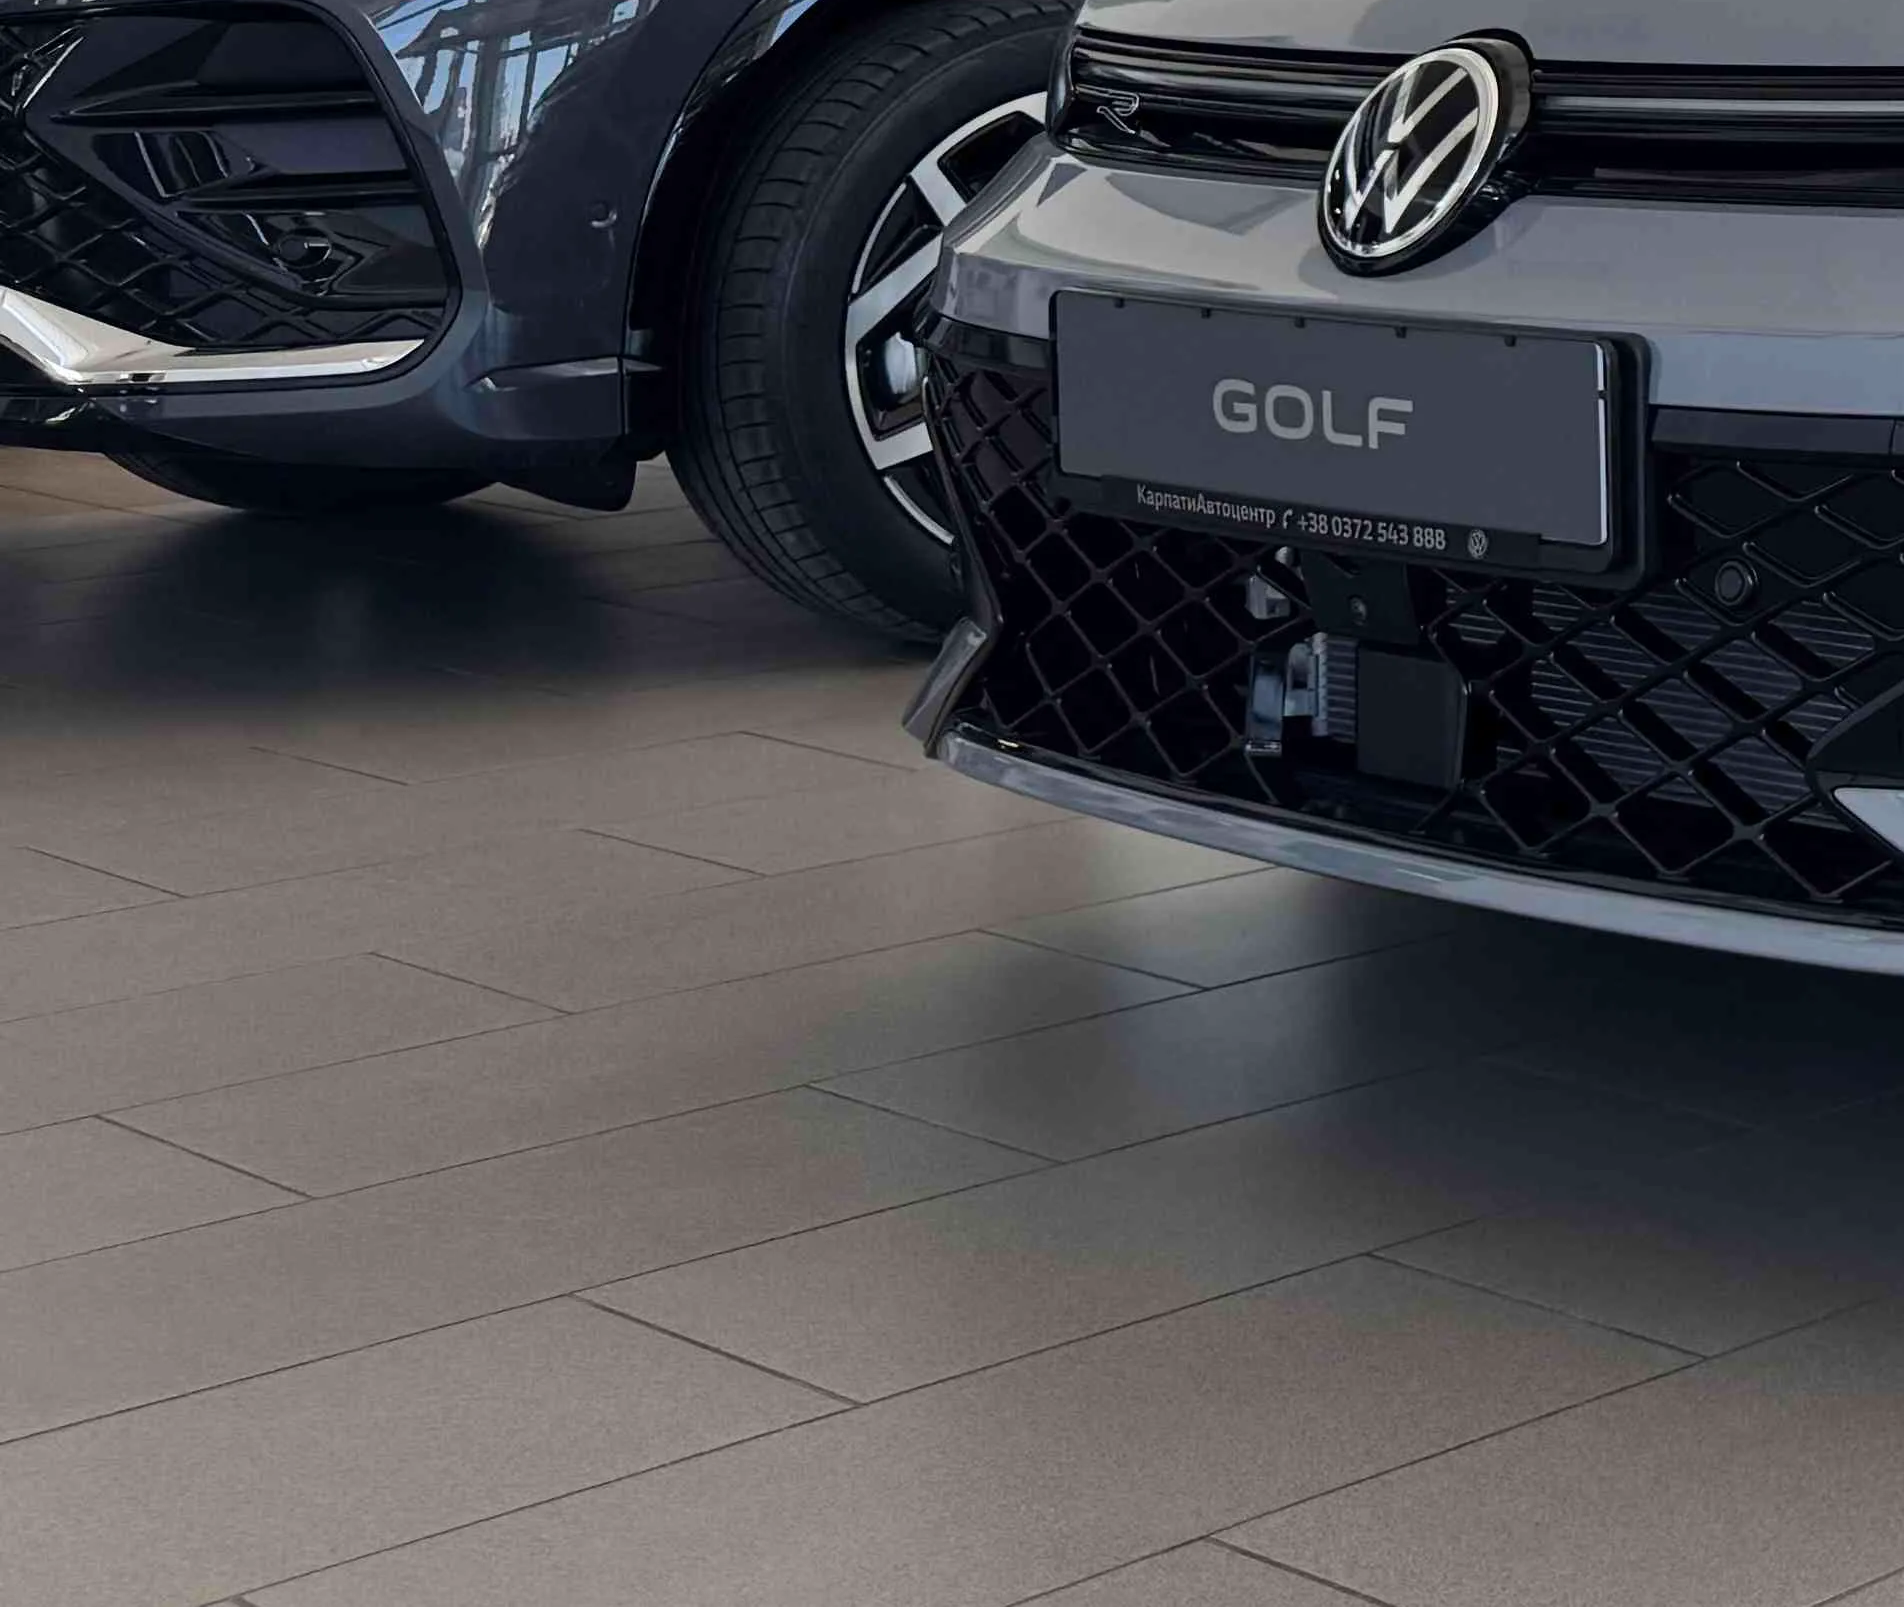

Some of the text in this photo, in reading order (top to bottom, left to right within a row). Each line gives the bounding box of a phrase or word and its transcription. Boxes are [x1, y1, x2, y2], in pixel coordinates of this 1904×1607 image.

[1212, 378, 1414, 450] GOLF
[1136, 483, 1448, 552] КарпатиАвтоцентр +38 0372 543 888
